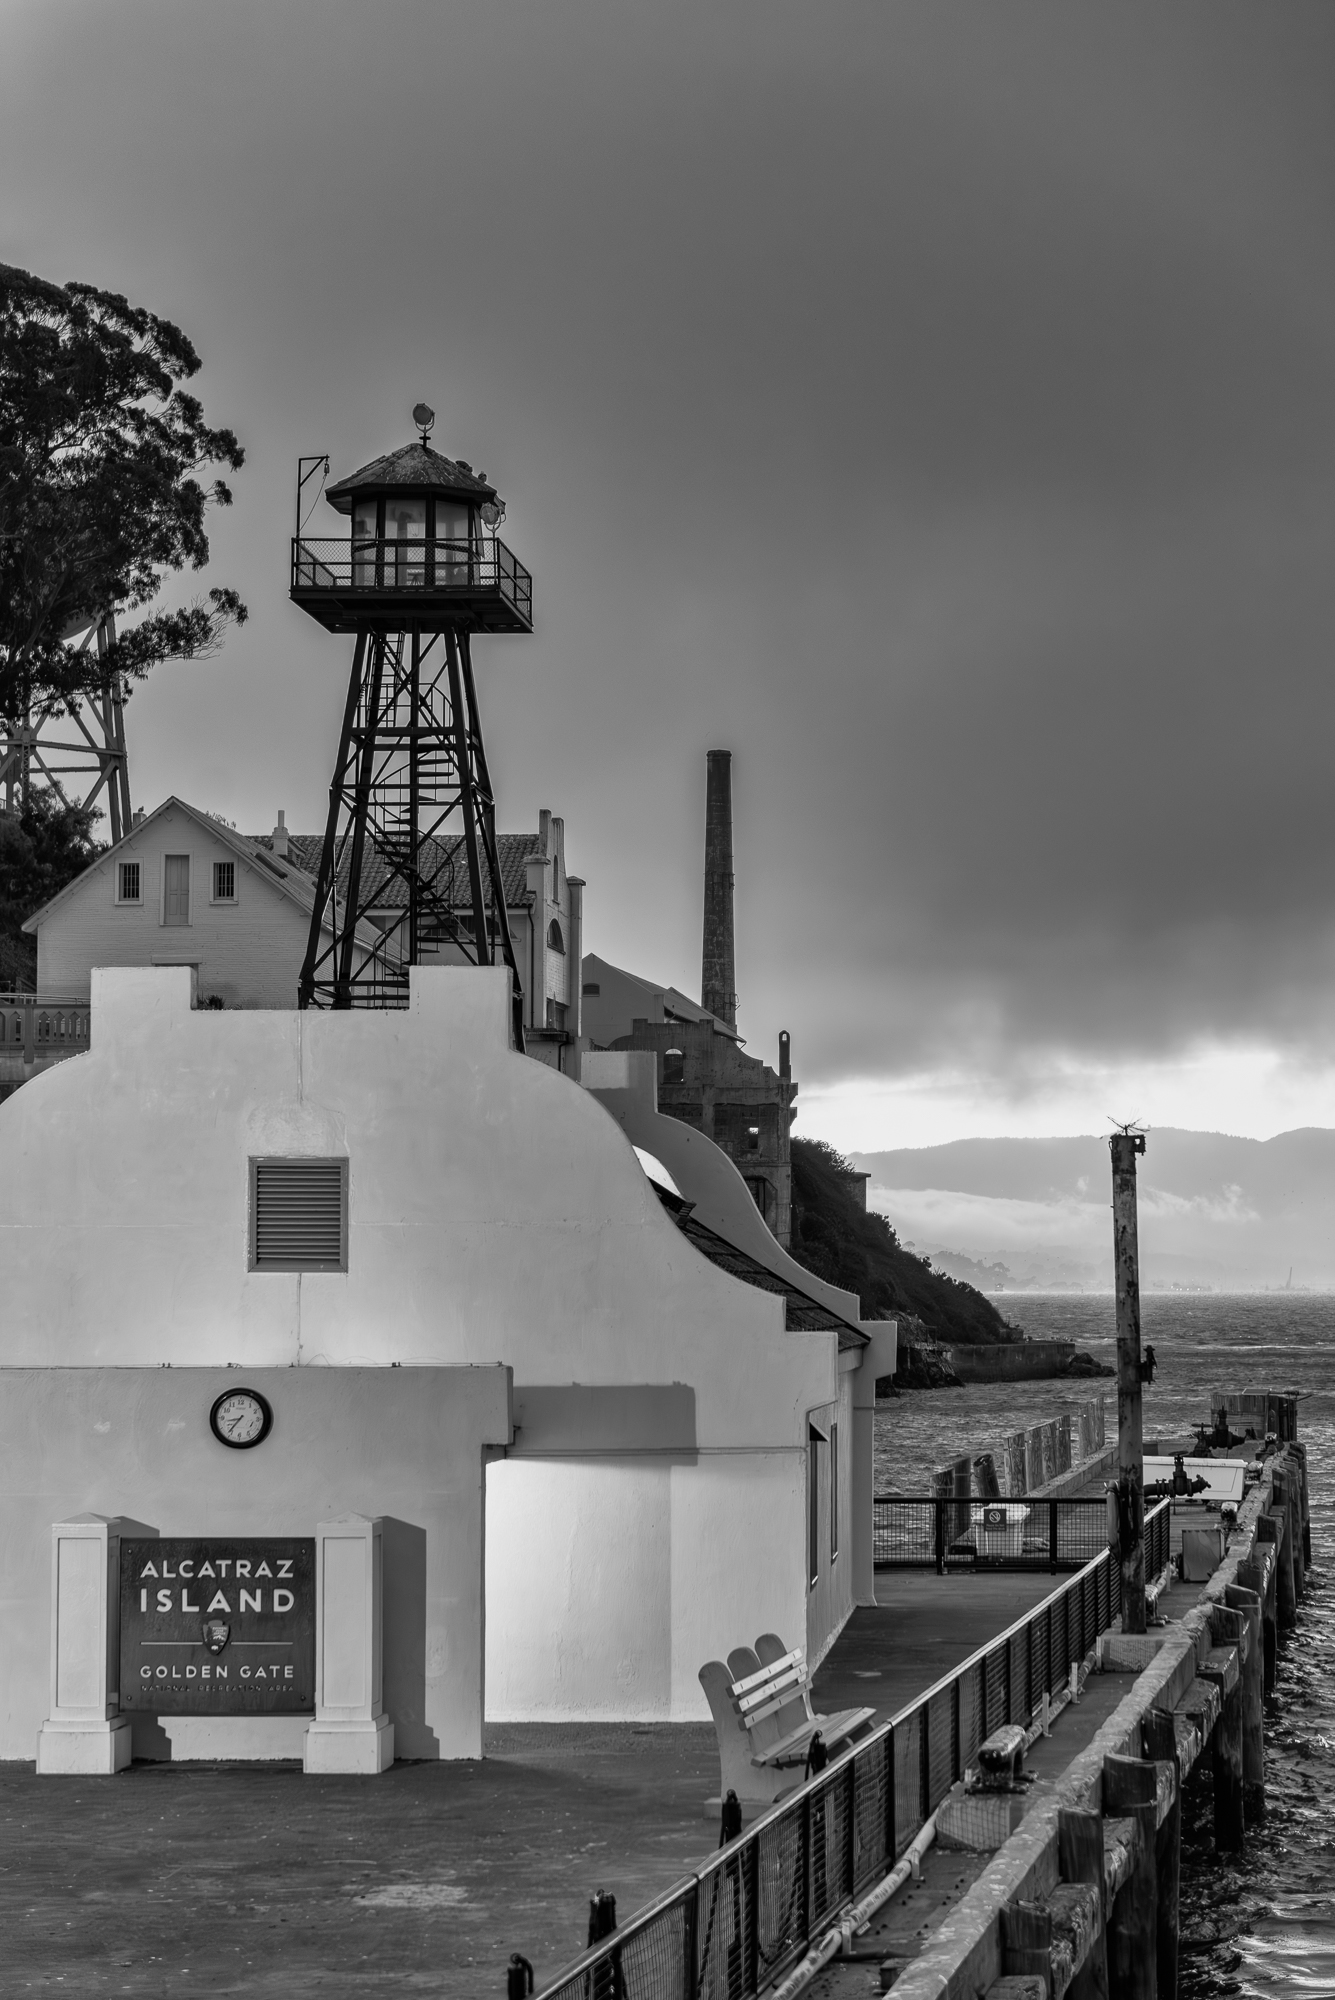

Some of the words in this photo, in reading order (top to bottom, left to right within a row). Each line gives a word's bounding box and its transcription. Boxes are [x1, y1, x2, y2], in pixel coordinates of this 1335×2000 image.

[140, 1559, 294, 1578] ALCATRAZ
[140, 1588, 295, 1613] ISLAND
[140, 1665, 228, 1679] GOLDEN
[239, 1665, 294, 1679] GATE
